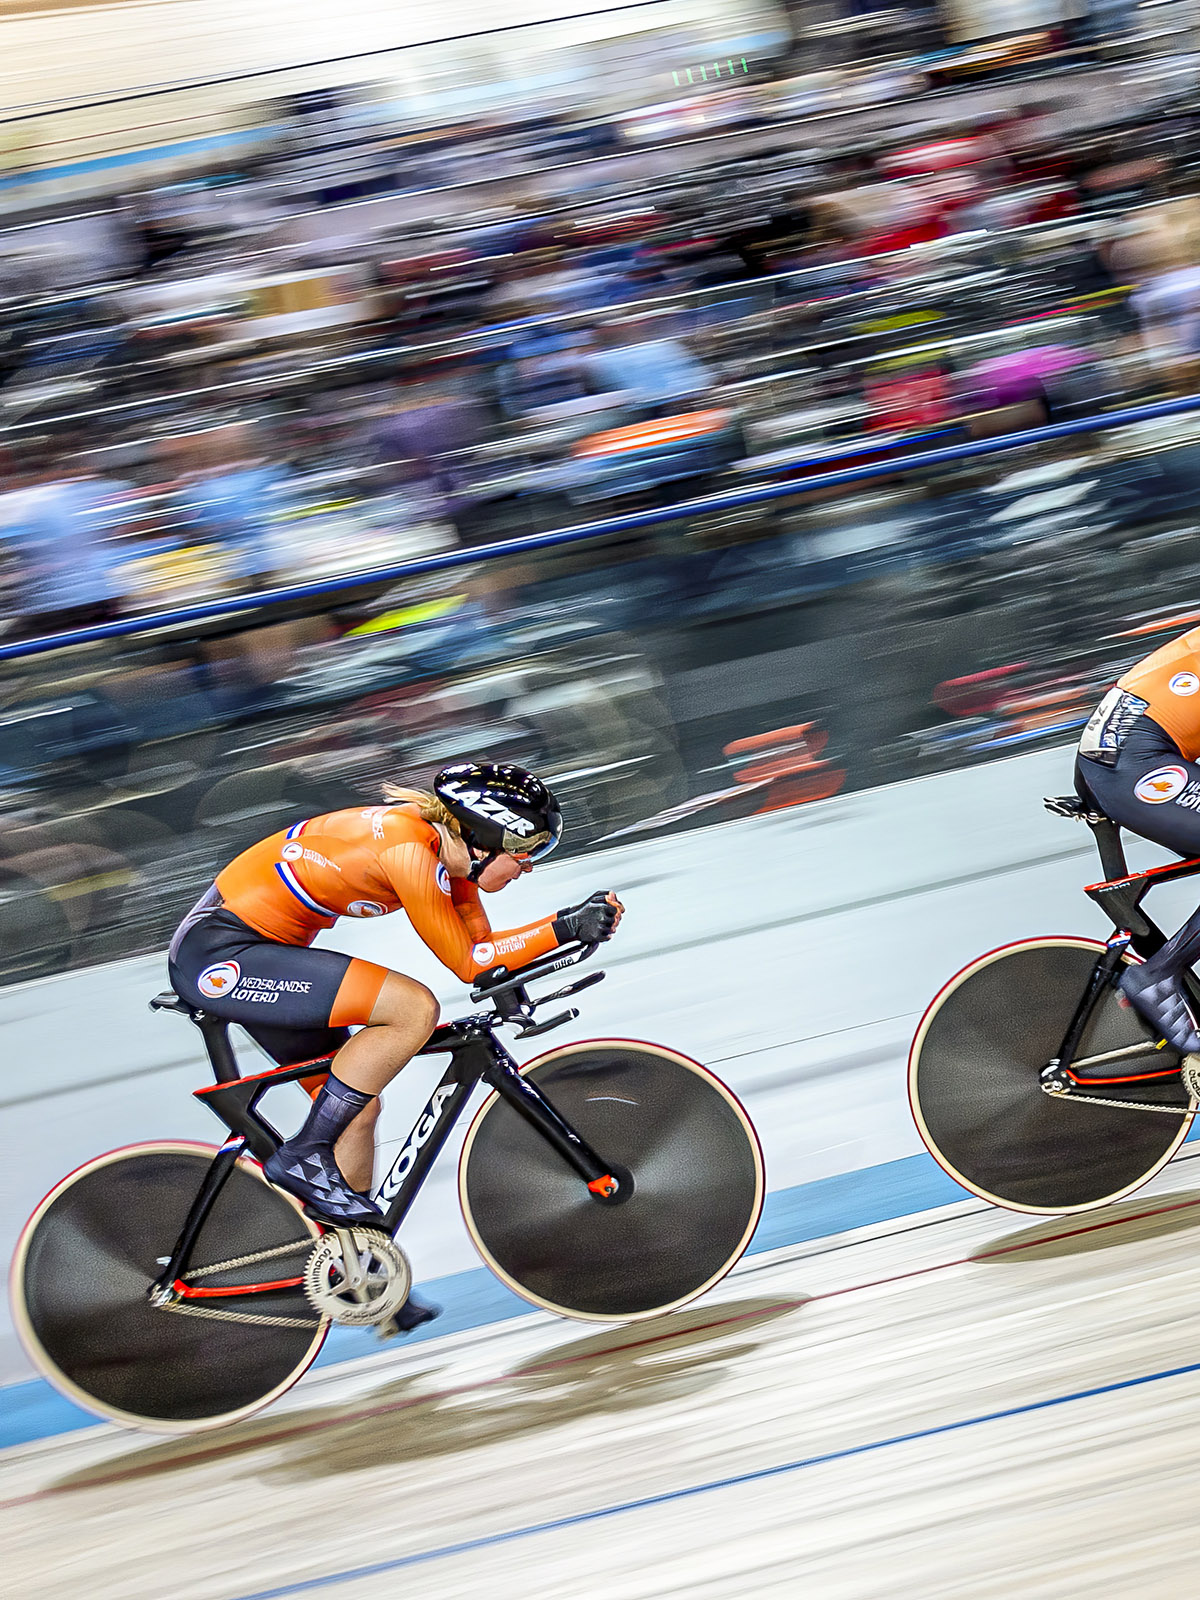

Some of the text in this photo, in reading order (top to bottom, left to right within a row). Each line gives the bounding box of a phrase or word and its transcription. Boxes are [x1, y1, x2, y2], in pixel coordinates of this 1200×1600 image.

[439, 780, 536, 837] LAZER
[230, 987, 280, 1004] LOTERIJ
[238, 976, 313, 994] NEDERLANDSE
[374, 1081, 459, 1216] KOGA
